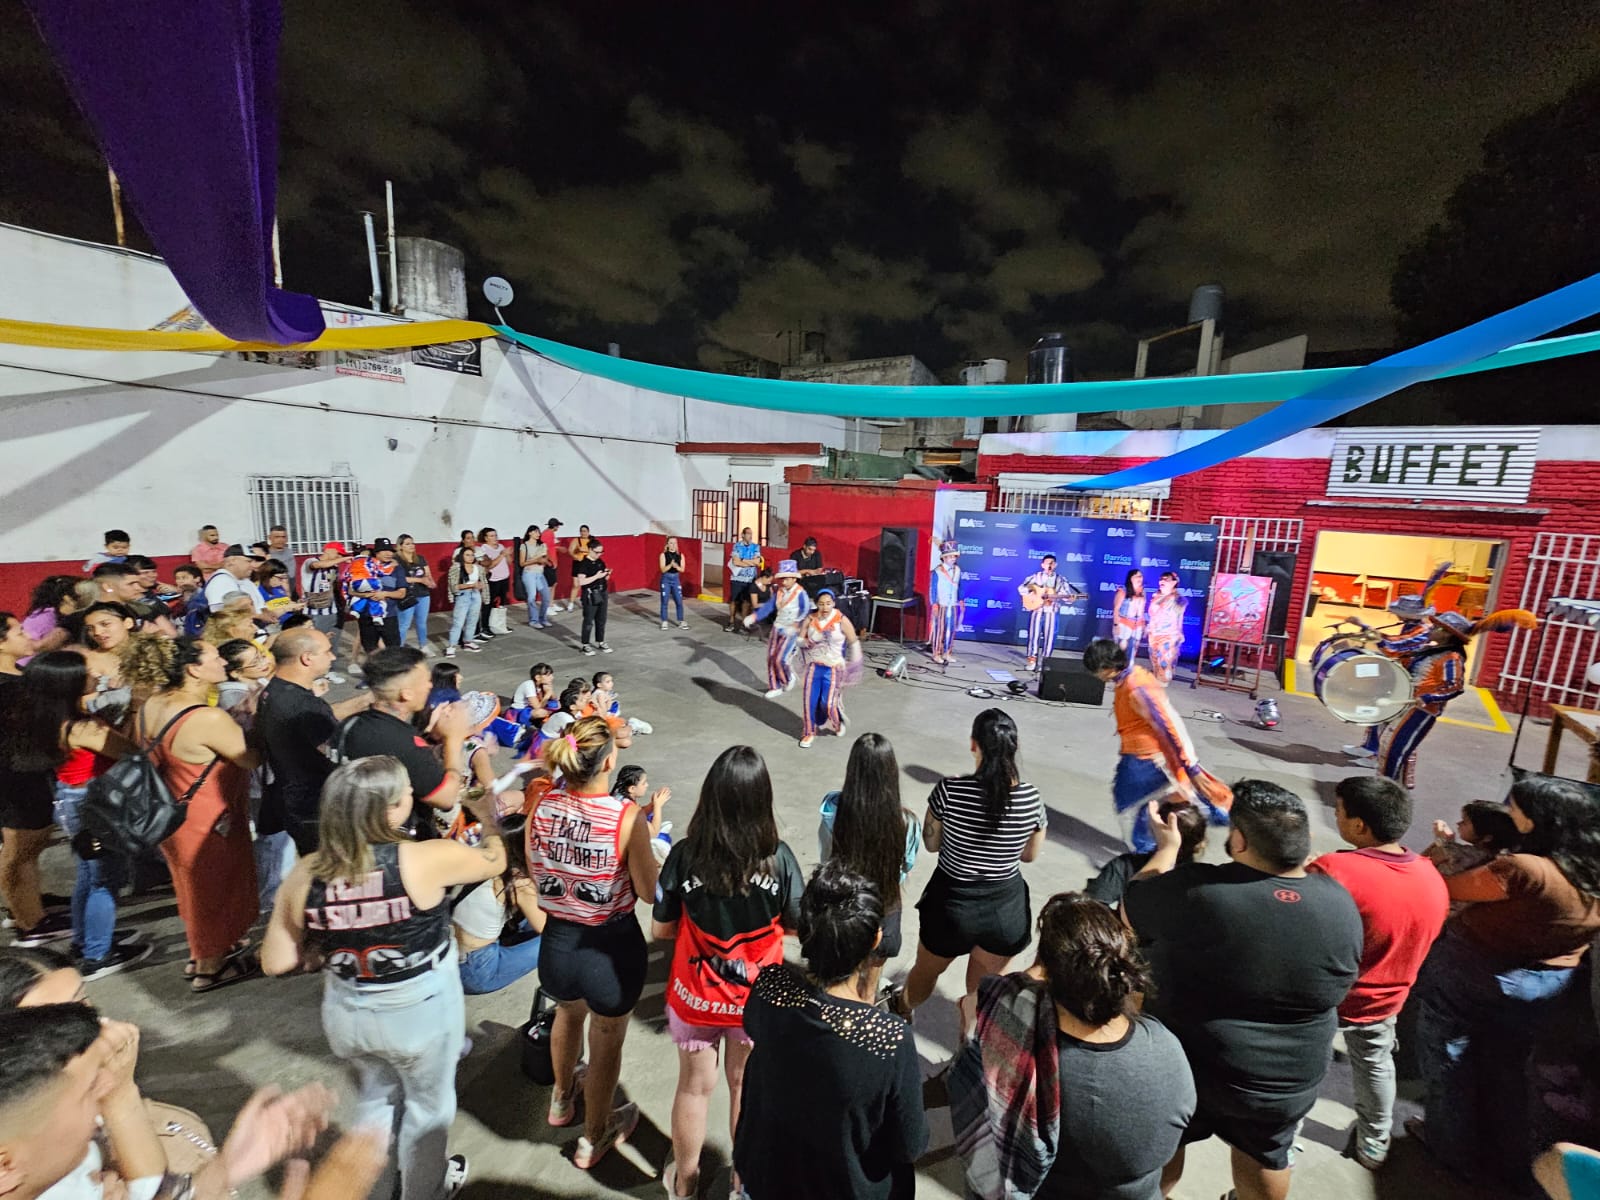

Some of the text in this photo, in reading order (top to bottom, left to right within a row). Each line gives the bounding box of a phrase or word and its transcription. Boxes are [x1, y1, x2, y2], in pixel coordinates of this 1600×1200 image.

[1343, 444, 1519, 486] BUFFET
[550, 813, 592, 843] TEAM
[673, 977, 710, 1012] TIGRES
